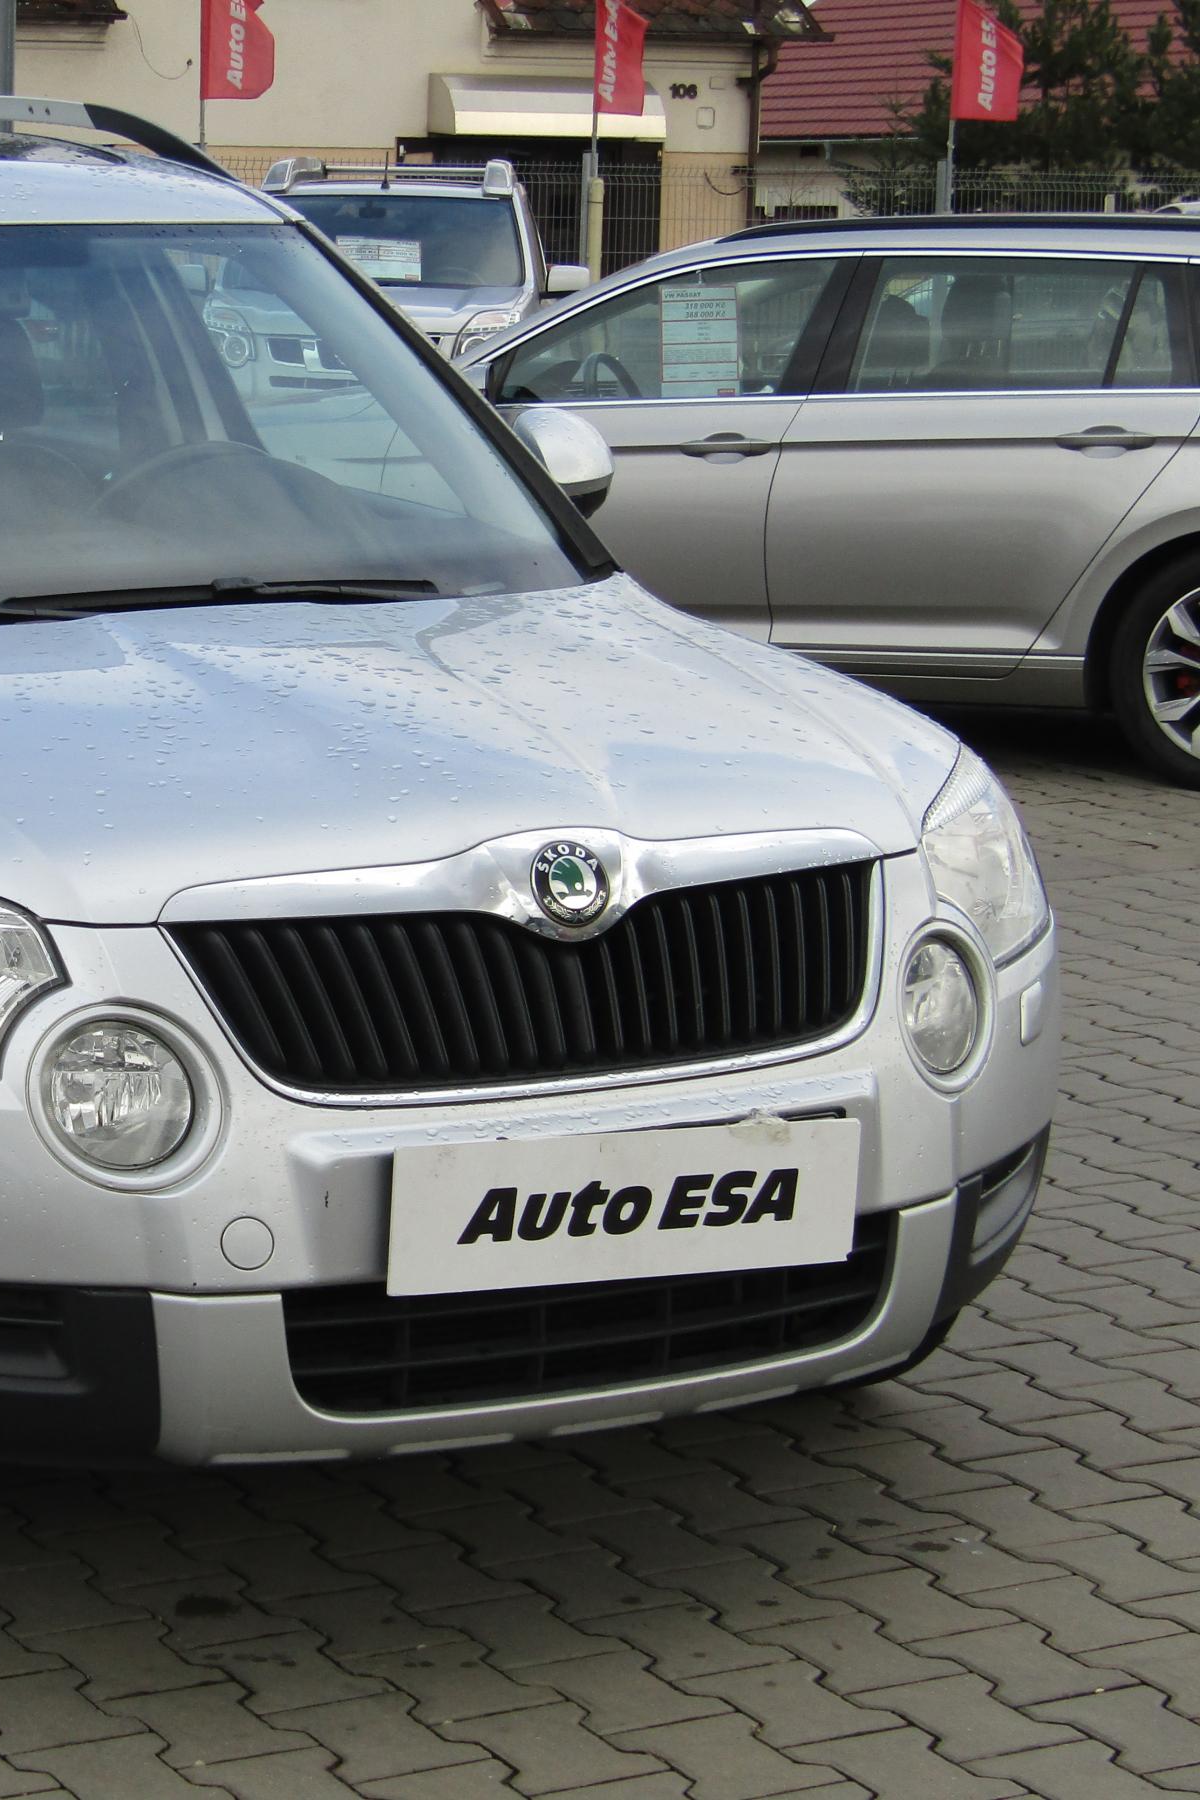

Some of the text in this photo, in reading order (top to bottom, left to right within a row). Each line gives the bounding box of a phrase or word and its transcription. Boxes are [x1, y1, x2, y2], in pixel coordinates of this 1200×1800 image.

[227, 23, 245, 91] Auto
[978, 49, 996, 112] Auto
[669, 83, 698, 100] 106
[457, 1168, 799, 1245] Auto ESA
